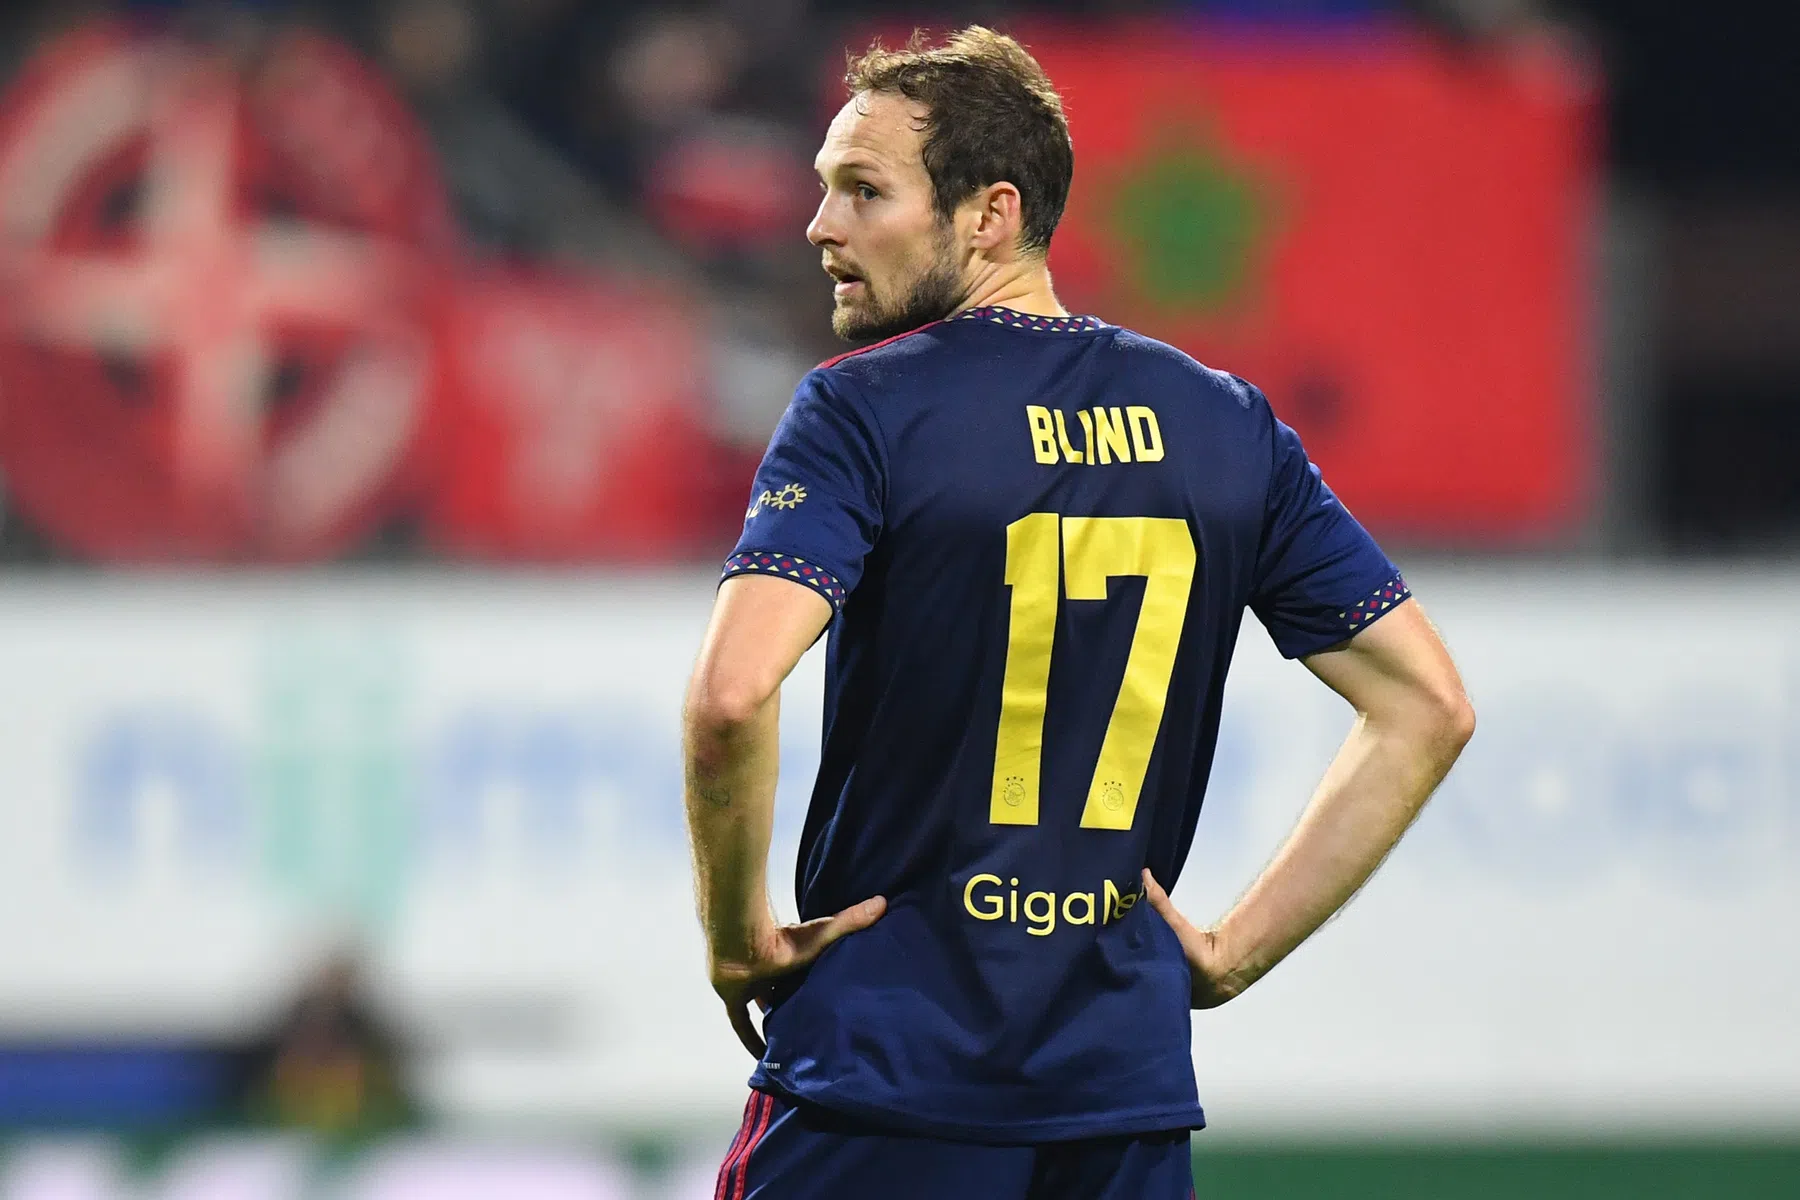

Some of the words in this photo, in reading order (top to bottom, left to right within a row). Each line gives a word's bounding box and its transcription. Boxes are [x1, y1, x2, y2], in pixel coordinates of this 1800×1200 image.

[1026, 405, 1165, 466] BLIND
[989, 512, 1197, 830] 17
[963, 873, 1145, 936] GigaNe
